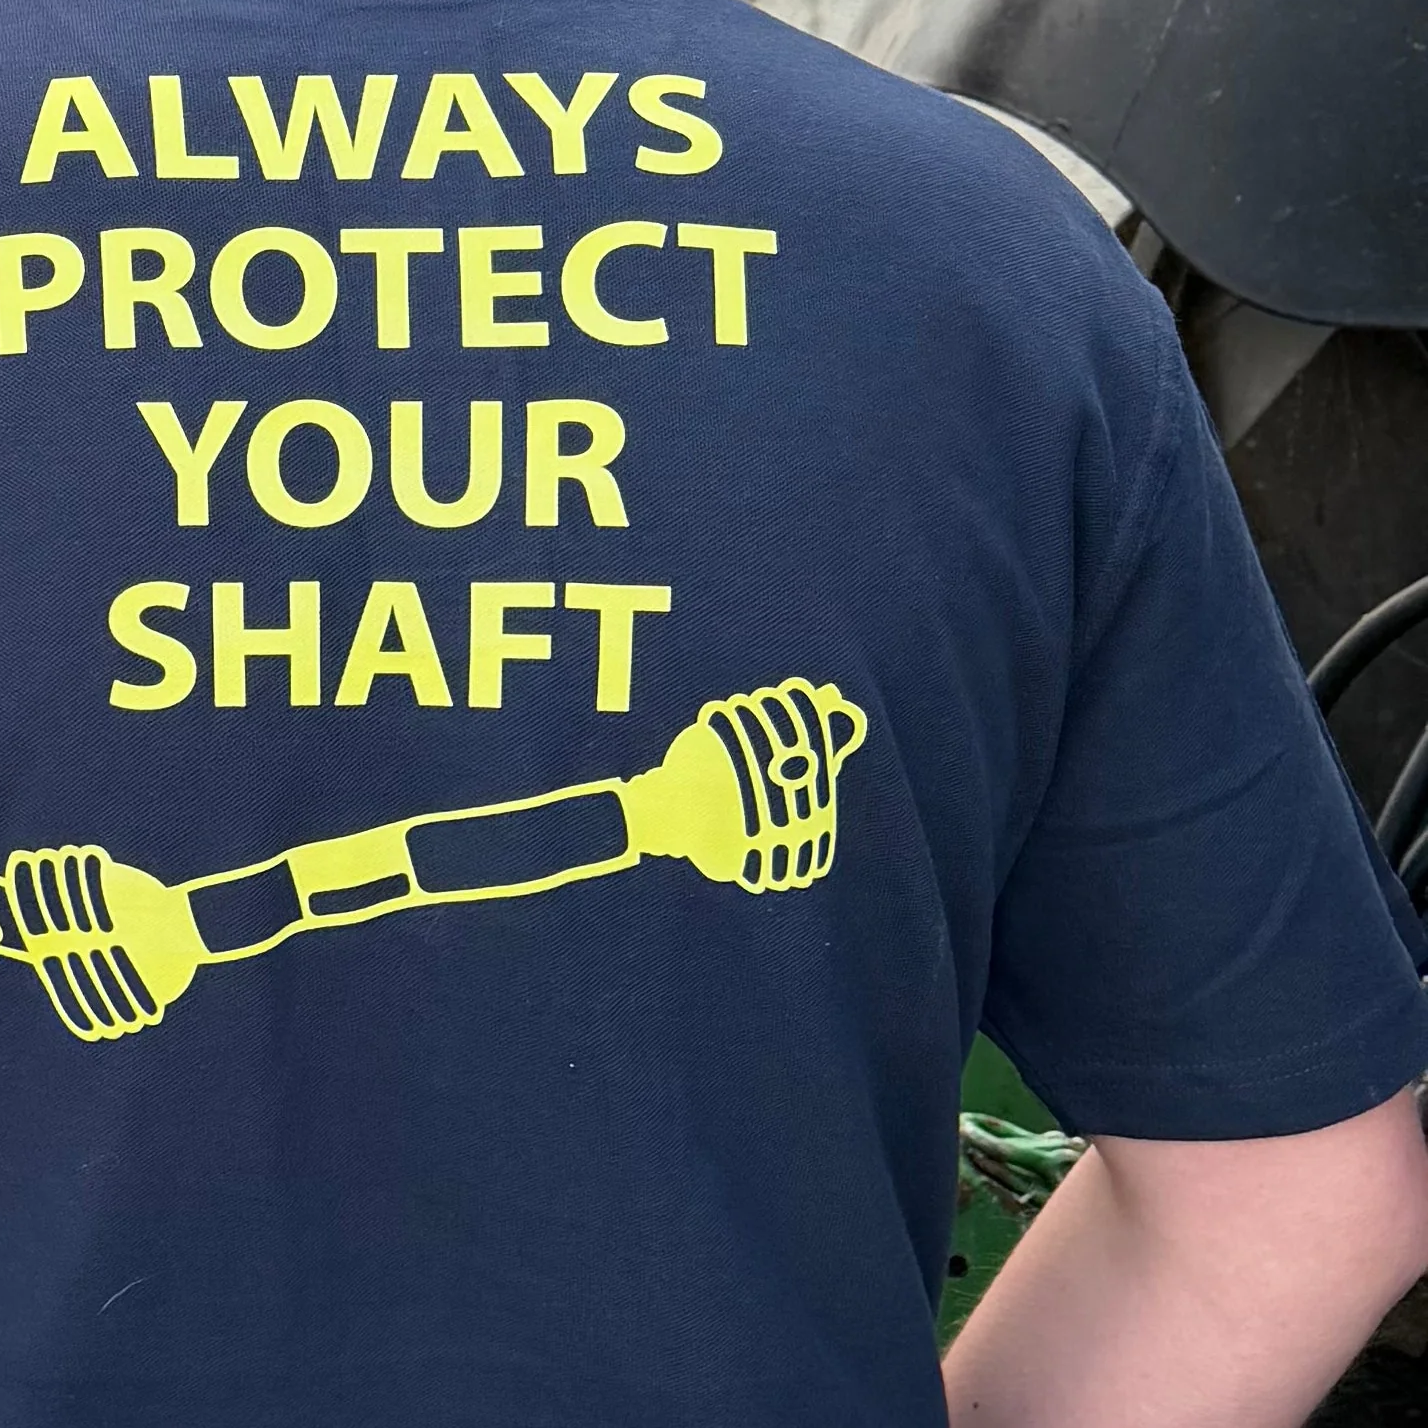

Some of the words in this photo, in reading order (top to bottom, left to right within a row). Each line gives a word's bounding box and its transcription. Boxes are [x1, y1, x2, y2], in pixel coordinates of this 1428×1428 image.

[20, 72, 724, 184] ALWAYS
[135, 398, 630, 528] YOUR
[108, 581, 673, 713] SHAFT
